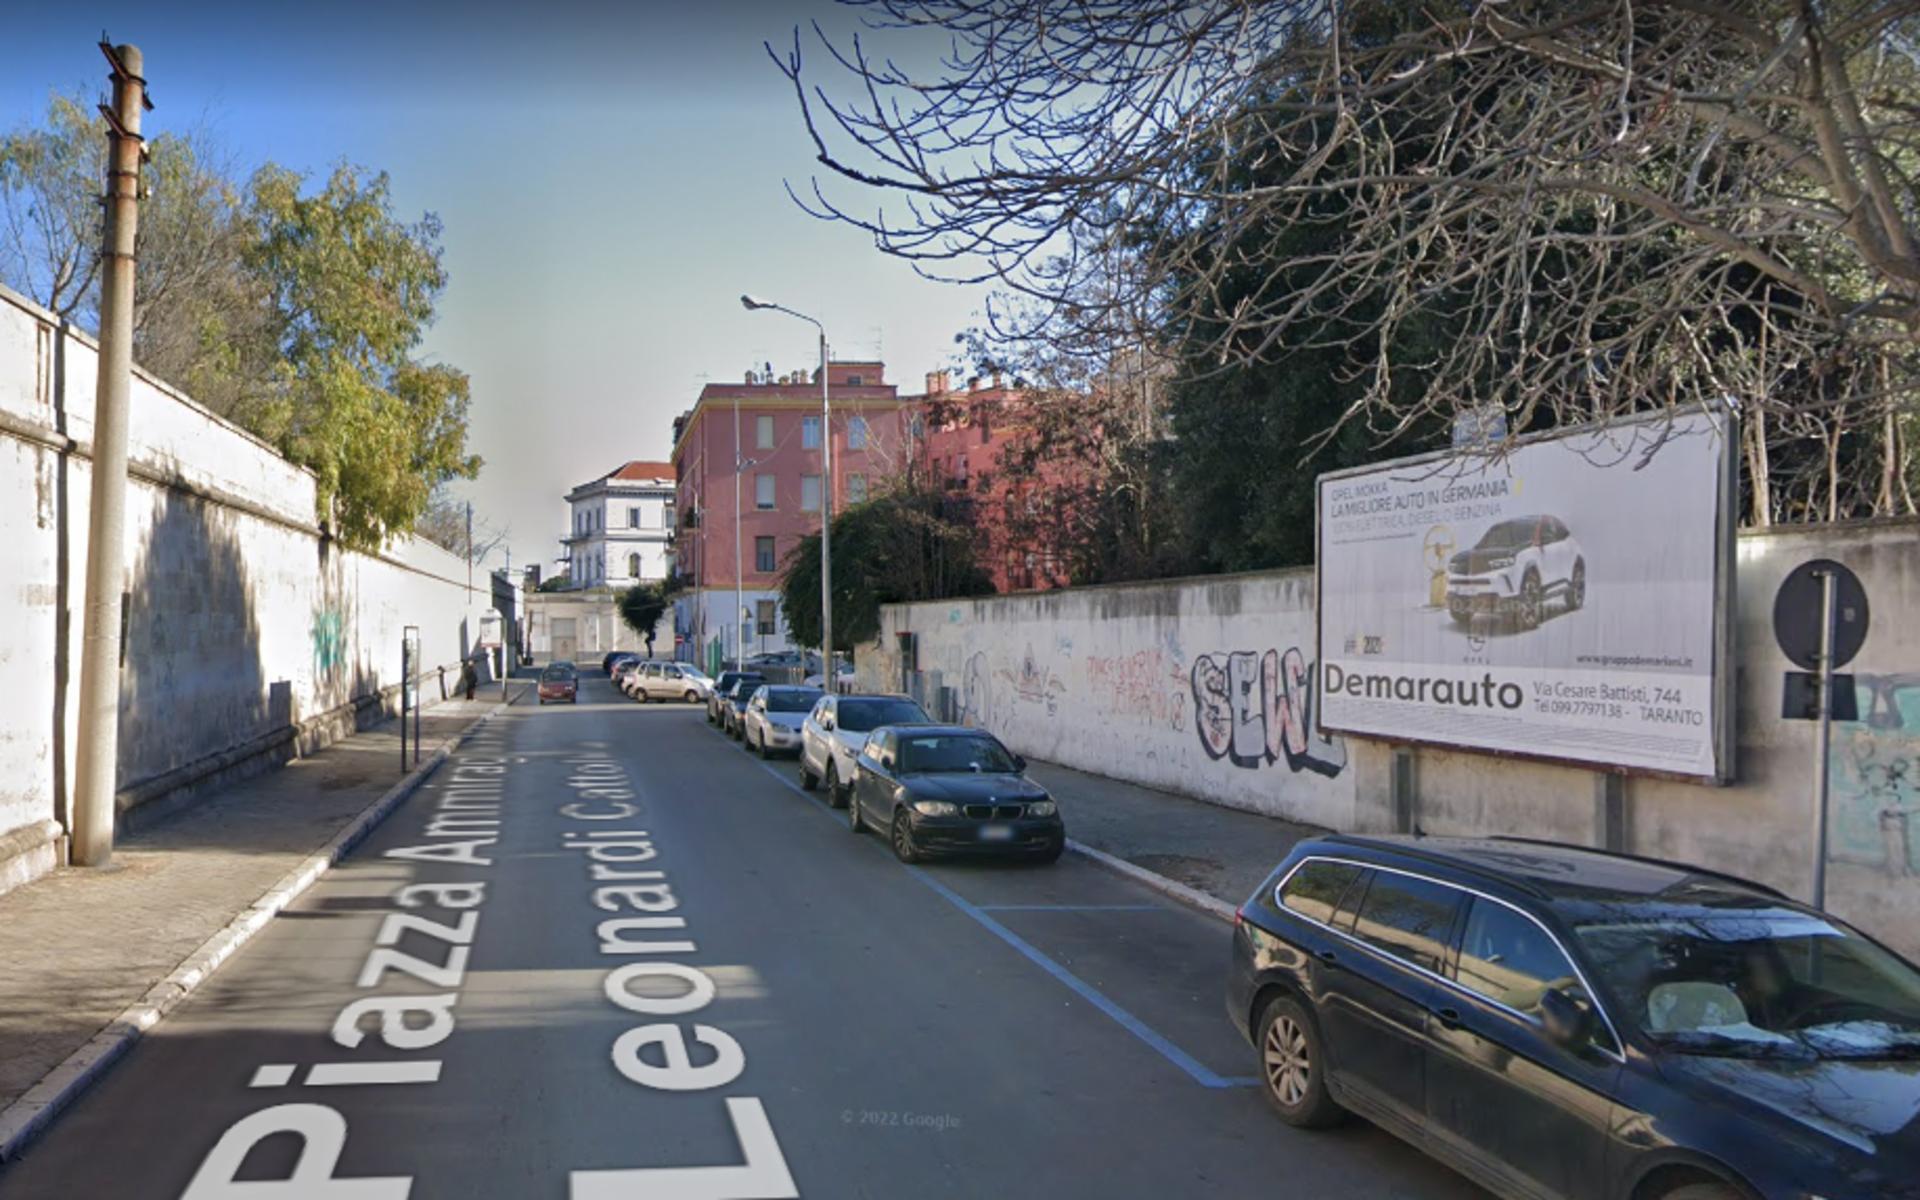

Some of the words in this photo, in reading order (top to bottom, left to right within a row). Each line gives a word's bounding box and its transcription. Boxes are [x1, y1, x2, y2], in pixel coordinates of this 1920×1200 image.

[1394, 493, 1425, 509] AUTO
[1428, 490, 1440, 505] IN
[1442, 479, 1509, 504] GERMANIA
[1324, 663, 1524, 711] Demarauto
[1533, 681, 1553, 697] Via
[1554, 682, 1597, 698] Cesare
[1600, 683, 1650, 705] Battisti,
[1654, 687, 1682, 705] 744
[1639, 705, 1704, 727] TARANTO
